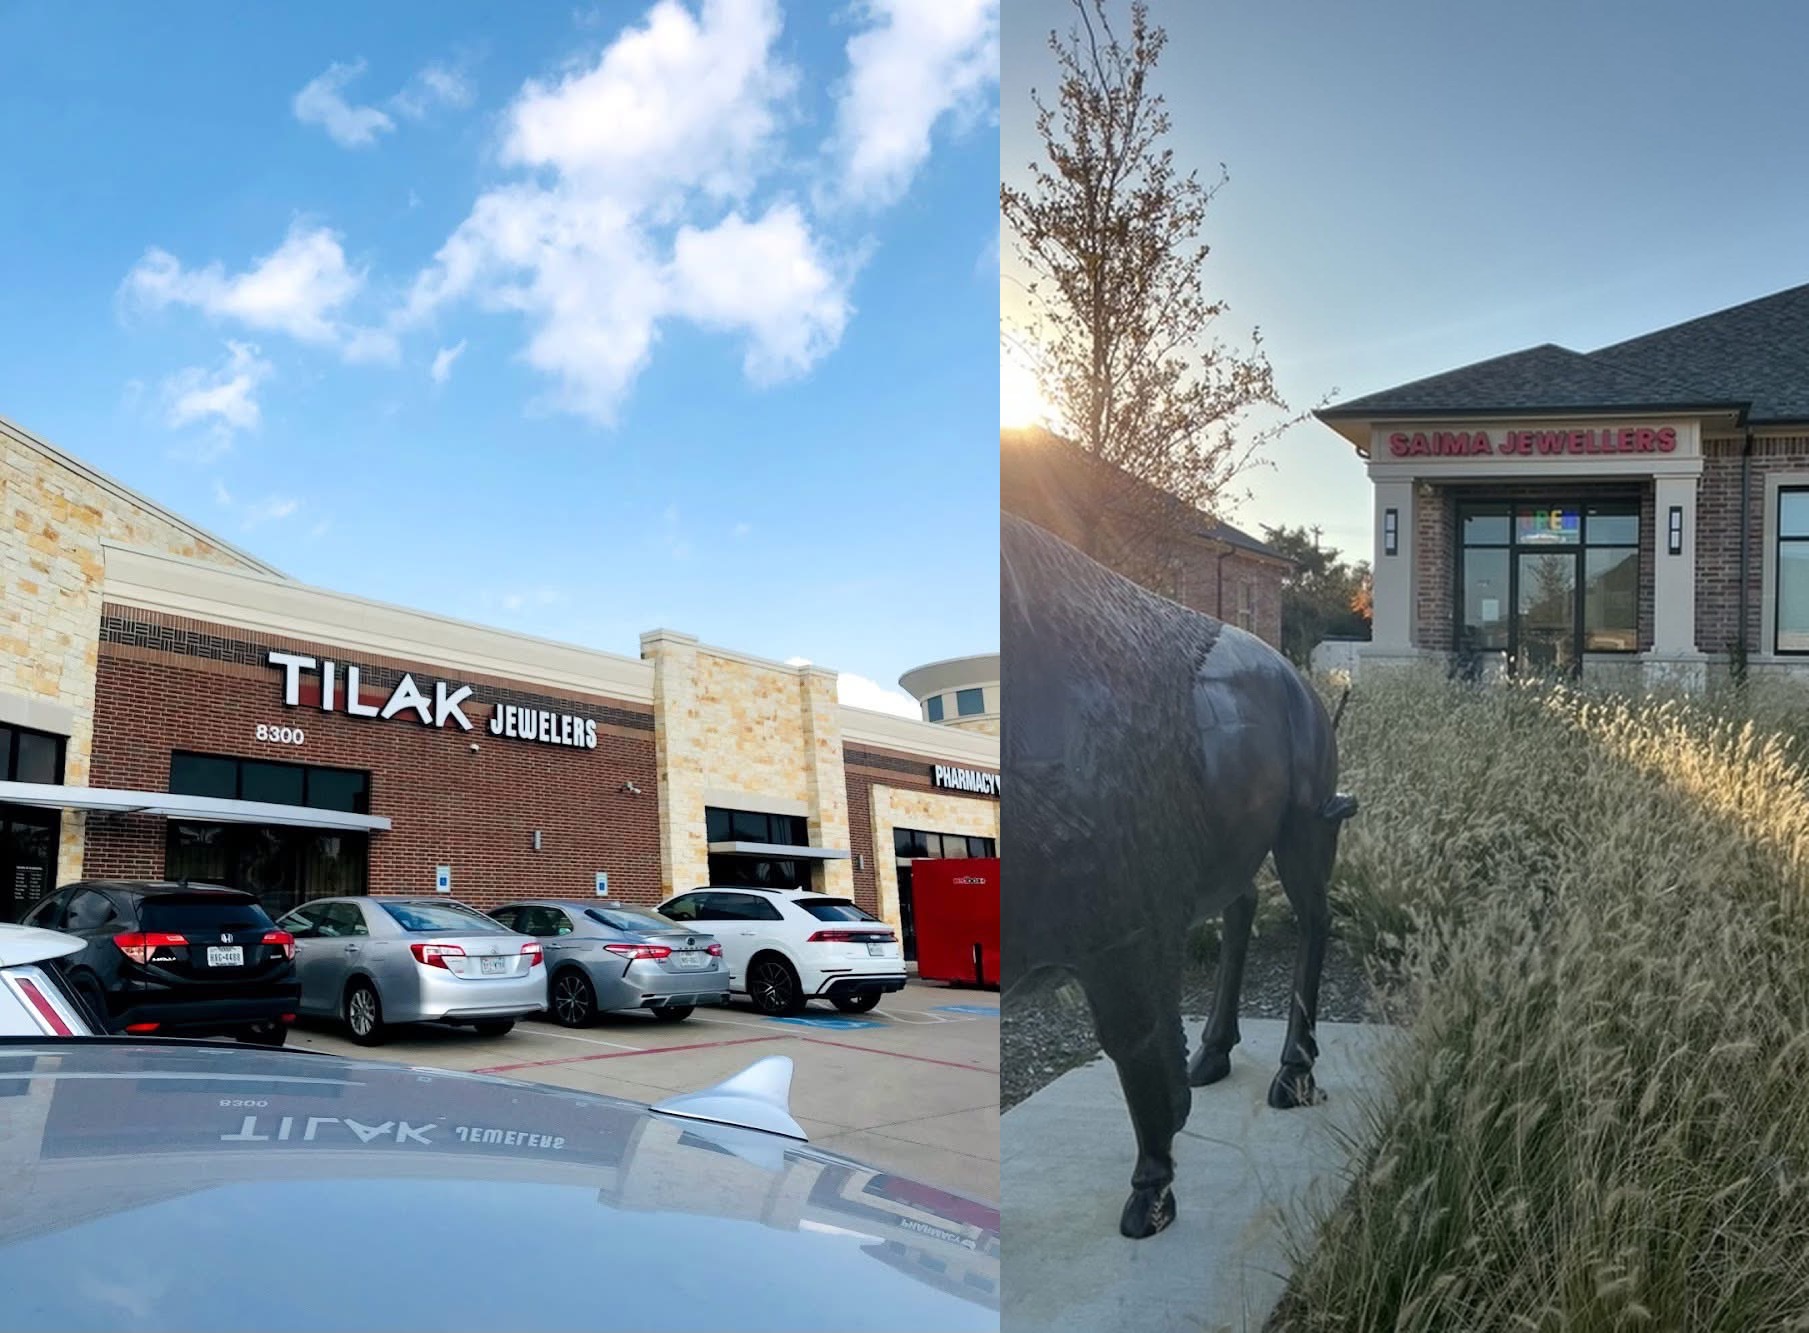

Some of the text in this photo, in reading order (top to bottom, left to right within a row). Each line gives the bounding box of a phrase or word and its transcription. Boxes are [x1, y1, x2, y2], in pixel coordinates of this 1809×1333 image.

[1389, 427, 1677, 457] SAIMA JEWELLERS
[268, 652, 597, 749] TILAK JEWELERS
[255, 723, 305, 746] 8300
[934, 764, 995, 795] PHARMACY
